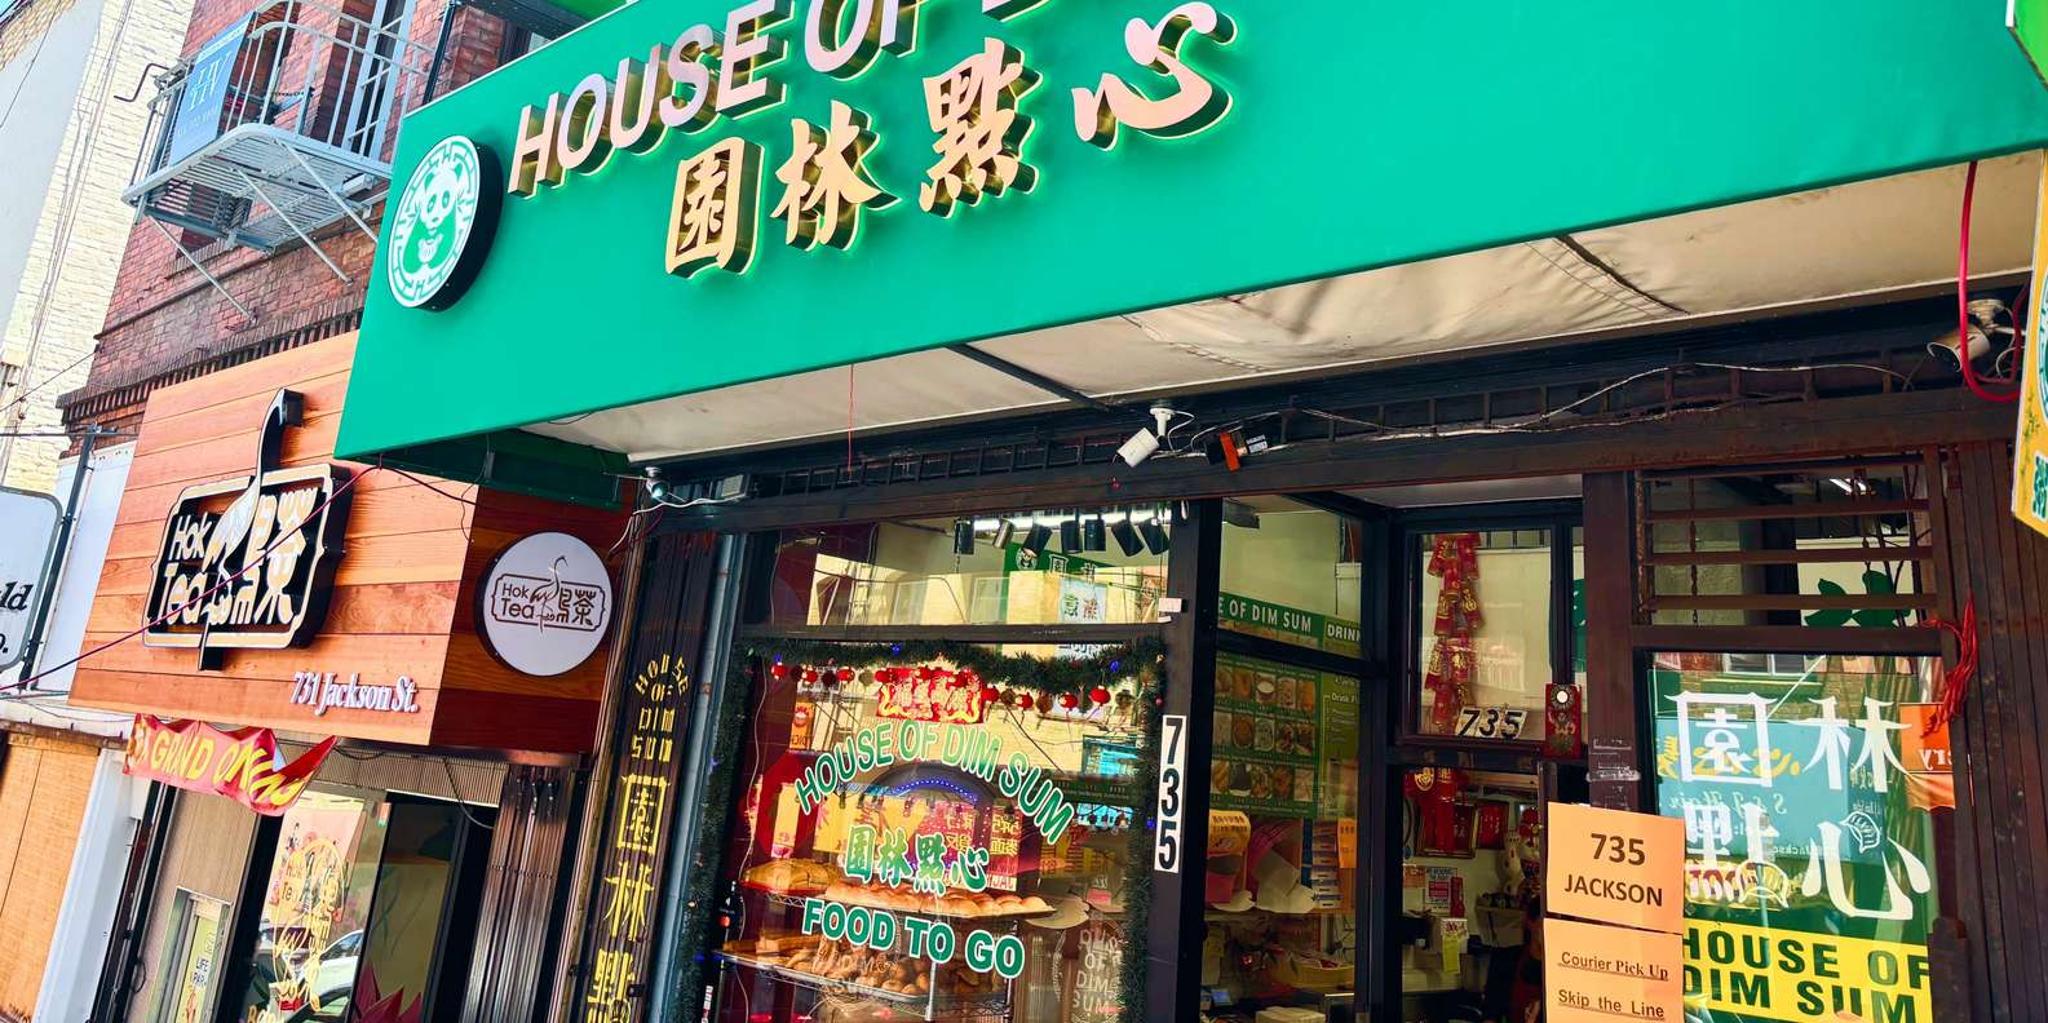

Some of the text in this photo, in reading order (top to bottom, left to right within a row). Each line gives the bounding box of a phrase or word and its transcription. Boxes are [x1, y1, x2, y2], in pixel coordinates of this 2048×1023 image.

[508, 0, 782, 196] HOUSE
[664, 1, 1225, 277] 園林點心
[168, 511, 213, 562] Hok
[157, 562, 209, 626] Tea
[501, 583, 530, 599] Hok
[501, 598, 535, 619] Tea
[1229, 600, 1247, 619] OF
[1252, 604, 1278, 625] DIM
[1283, 611, 1312, 633] SUM
[290, 671, 420, 716] 731 Jackson St.
[634, 654, 690, 696] HOUSE
[638, 707, 676, 732] DIM
[1458, 708, 1523, 739] 735
[151, 730, 216, 781] GRAND
[631, 735, 673, 763] SUM
[795, 719, 1076, 846] HOUSE OF DIM SUM
[1158, 718, 1183, 871] 735
[844, 824, 990, 897] 園林點心
[1590, 832, 1646, 866] 735
[1564, 874, 1663, 907] JACKSON
[801, 897, 896, 951] FOOD
[904, 916, 956, 964] TO
[965, 929, 1026, 980] GO
[1561, 951, 1669, 981] Courier Pick Up
[1867, 949, 1931, 990] OF
[1558, 989, 1664, 1018] Skip the Line
[1796, 980, 1918, 1023] SUM
